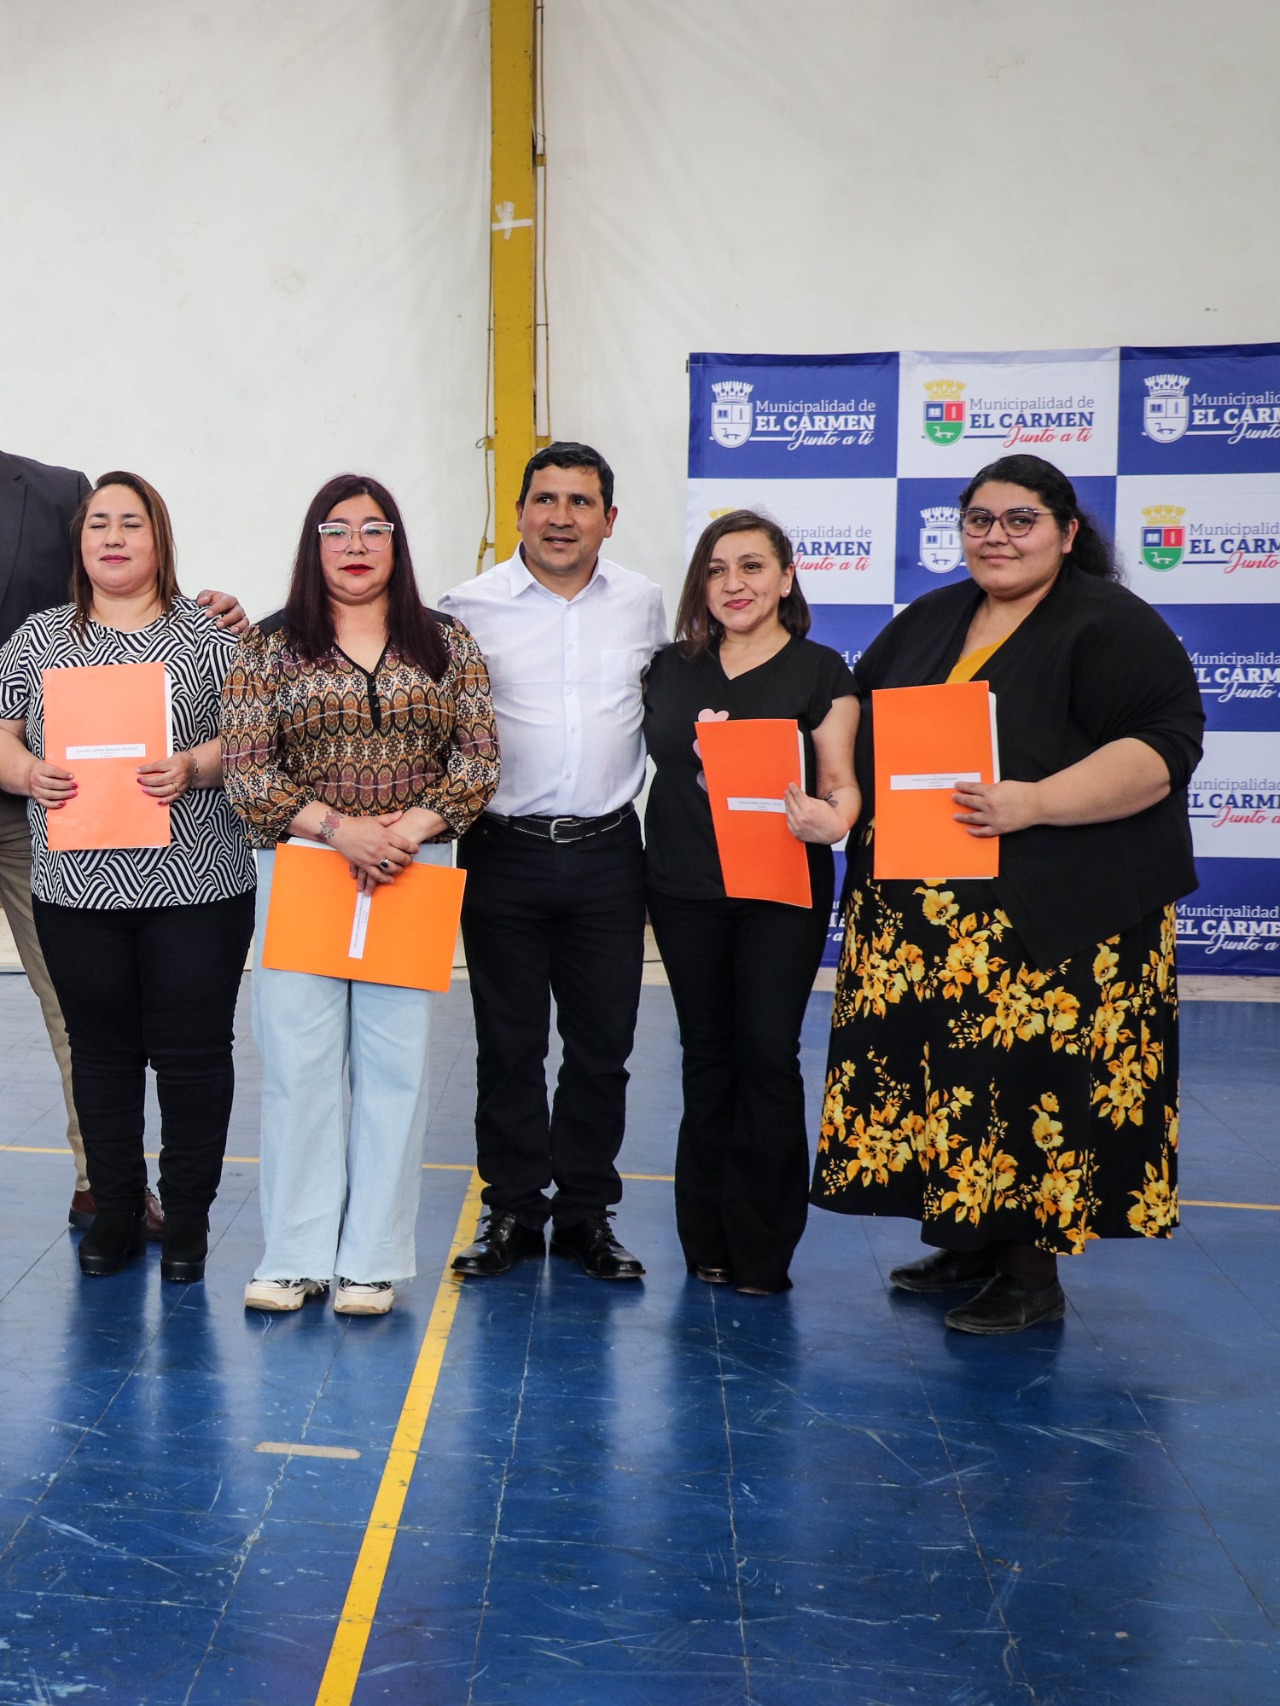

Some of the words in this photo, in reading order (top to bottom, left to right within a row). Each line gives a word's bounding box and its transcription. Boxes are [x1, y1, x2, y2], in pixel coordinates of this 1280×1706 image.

[755, 399, 855, 415] Municipalidad
[858, 399, 876, 412] de
[969, 396, 1073, 412] Municipalidad
[1077, 396, 1095, 409] de
[755, 416, 781, 431] EL
[783, 415, 876, 431] CARMEN
[969, 414, 995, 429] EL
[999, 412, 1095, 429] CARMEN
[1192, 409, 1220, 425] EL
[787, 429, 840, 451] Junto
[842, 434, 856, 445] a
[858, 430, 875, 445] ti
[1002, 426, 1058, 448] Junto
[1060, 431, 1073, 443] a
[1076, 427, 1094, 442] ti
[1227, 422, 1280, 445] Junto
[855, 526, 872, 538] de
[796, 541, 872, 556] ARMEN
[1189, 539, 1215, 554] EL
[839, 561, 852, 571] a
[854, 557, 871, 571] ti
[1224, 551, 1280, 574] Junto
[1194, 668, 1211, 683] L
[1217, 680, 1277, 703] Junto
[1211, 806, 1269, 828] Junto
[1176, 920, 1198, 935] EL
[1204, 932, 1263, 954] Junto
[1264, 942, 1280, 951] a
